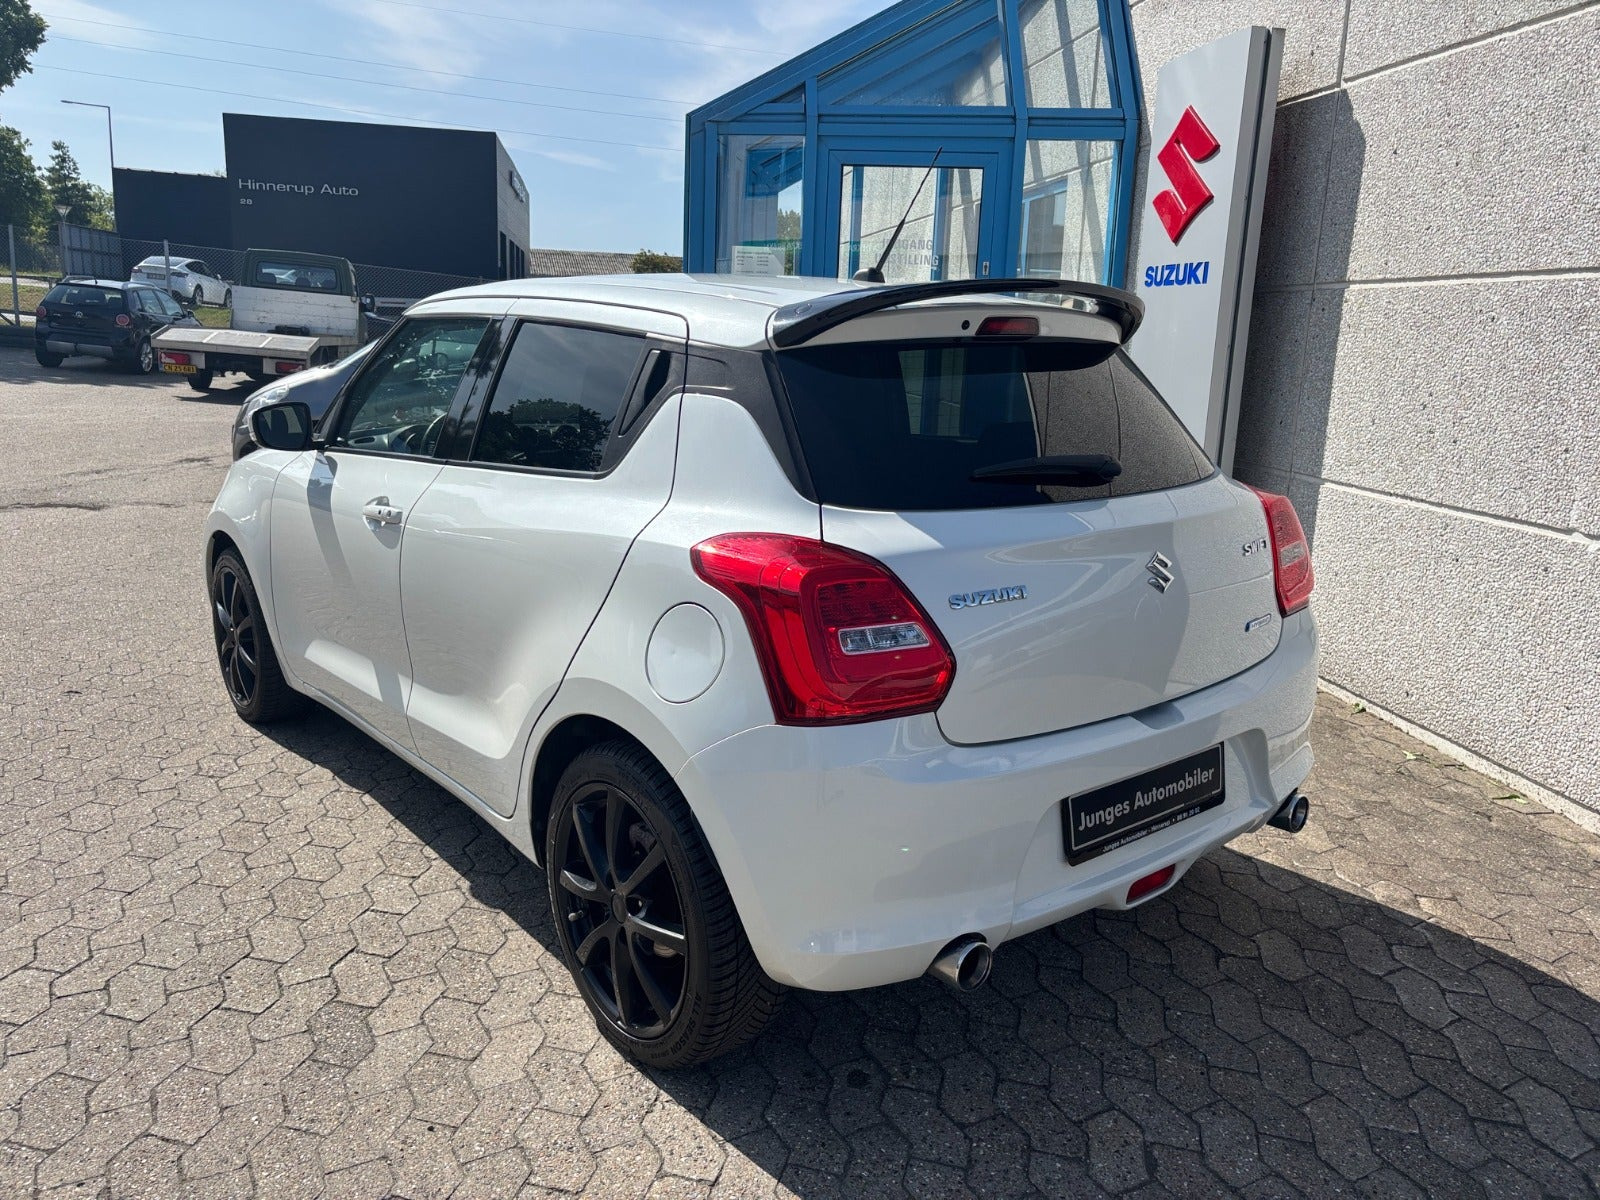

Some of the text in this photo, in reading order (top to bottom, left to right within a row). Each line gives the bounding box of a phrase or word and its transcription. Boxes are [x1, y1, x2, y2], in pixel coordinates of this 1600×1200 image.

[238, 179, 359, 196] Hinnerup Auto
[883, 238, 933, 251] IGANG
[875, 253, 939, 266] USTILLING
[1144, 261, 1210, 287] SUZUKI
[948, 585, 1027, 609] SUZUKI
[1078, 767, 1214, 831] Junges Automobiler
